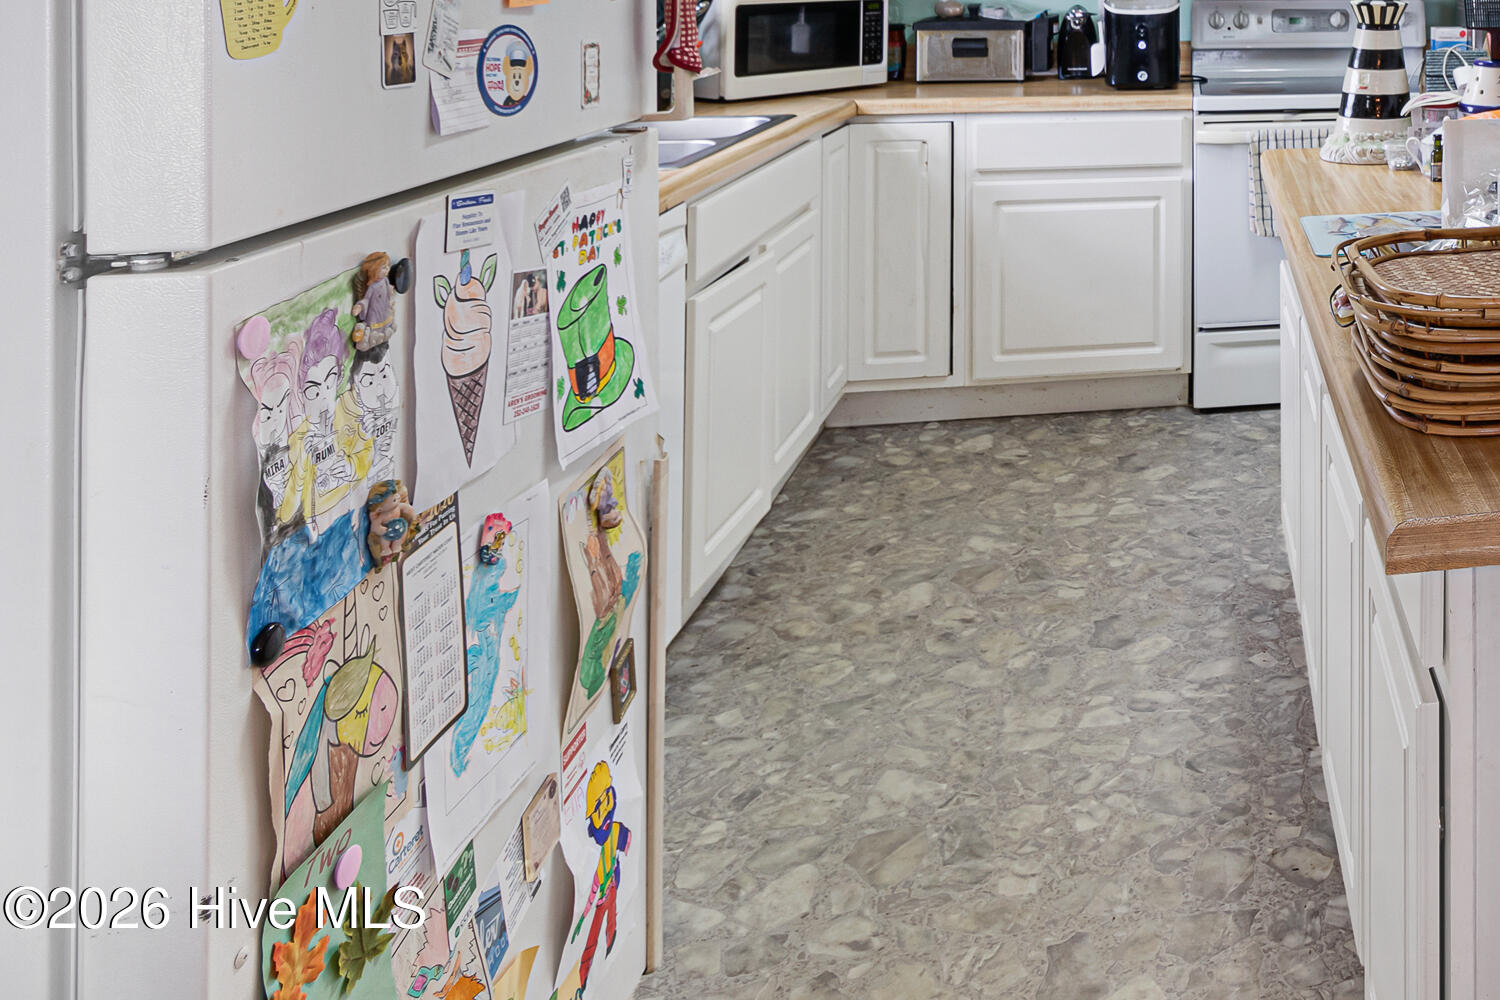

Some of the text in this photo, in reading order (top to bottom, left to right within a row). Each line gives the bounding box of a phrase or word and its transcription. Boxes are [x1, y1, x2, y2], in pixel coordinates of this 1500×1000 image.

[486, 63, 501, 73] HOPE
[571, 209, 605, 234] HAPPY
[572, 218, 622, 250] PATRICK'S
[577, 245, 601, 266] DAY
[375, 419, 392, 438] ZOEY
[264, 458, 285, 479] MIRA
[304, 827, 352, 889] TWO
[388, 824, 424, 875] Carteret
